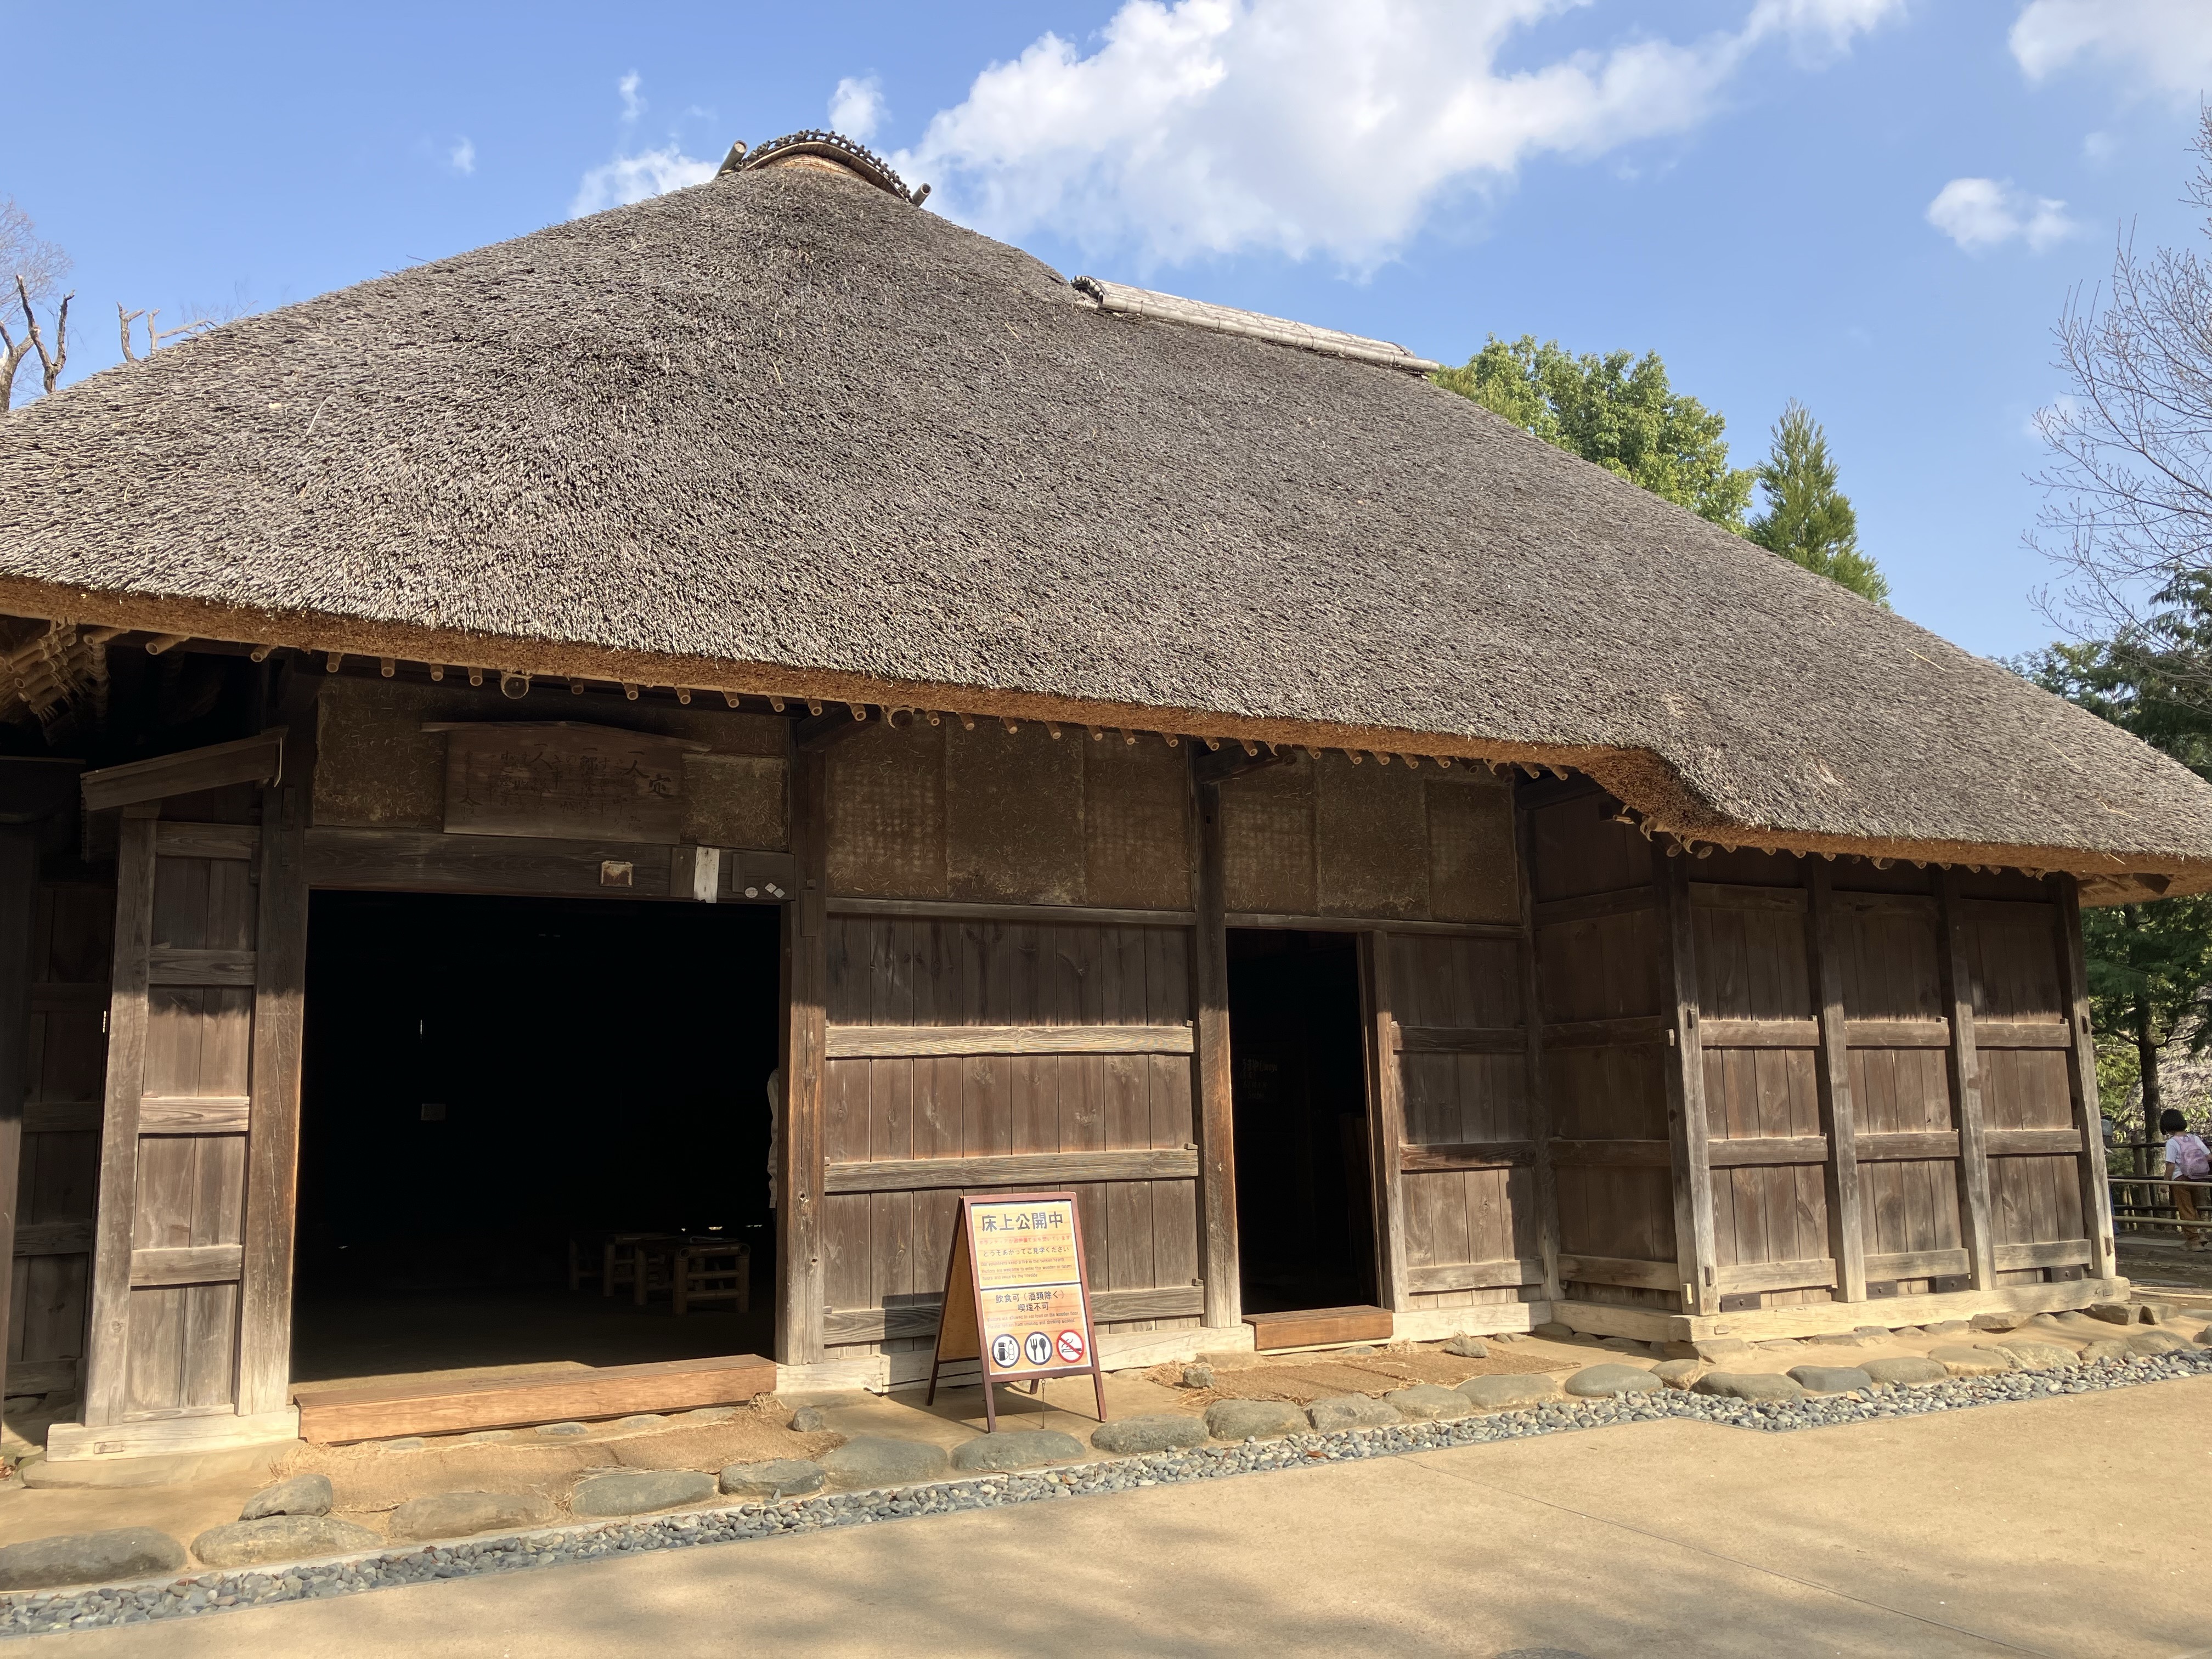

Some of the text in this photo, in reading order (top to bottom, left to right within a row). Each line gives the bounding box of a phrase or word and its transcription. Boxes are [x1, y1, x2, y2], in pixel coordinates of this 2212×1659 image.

[981, 1211, 1063, 1232] 床上公開中
[1017, 1302, 1049, 1312] 喫煙不可
